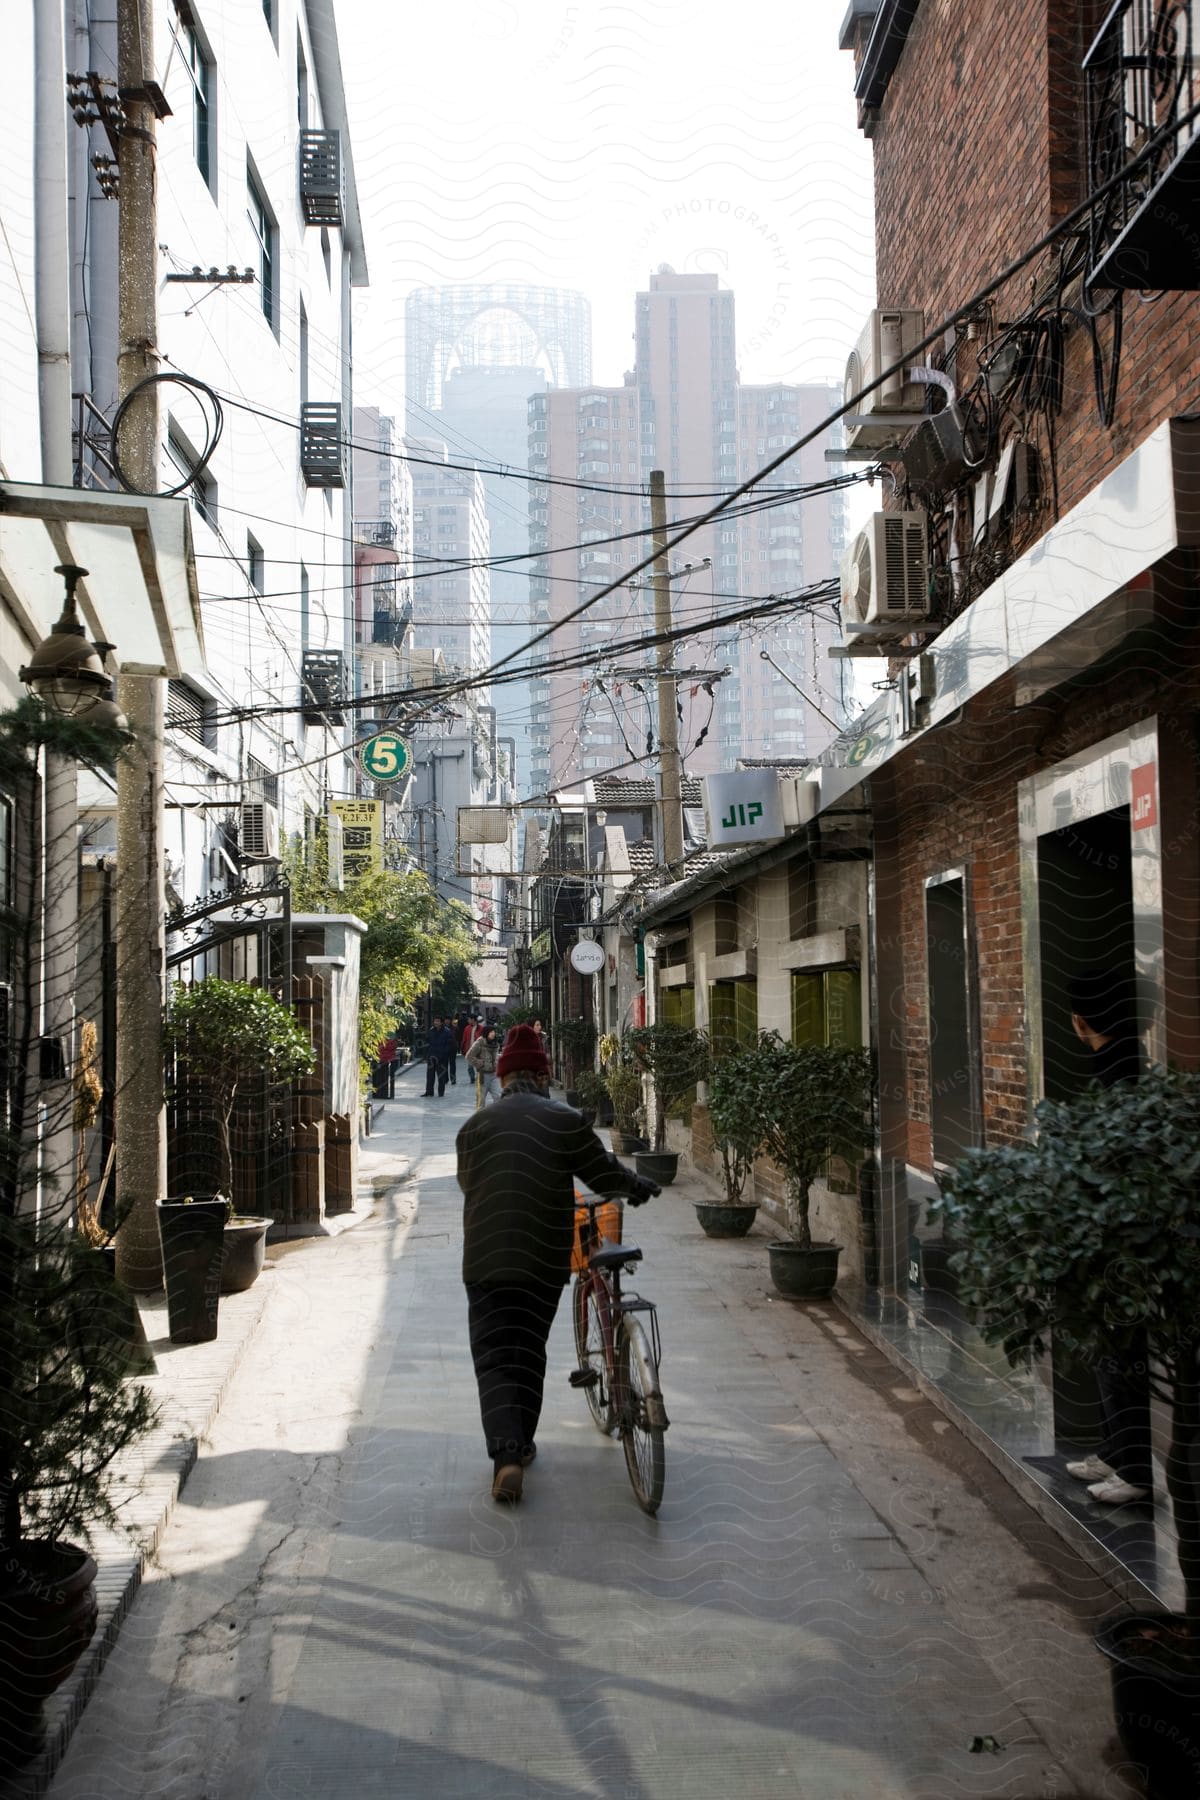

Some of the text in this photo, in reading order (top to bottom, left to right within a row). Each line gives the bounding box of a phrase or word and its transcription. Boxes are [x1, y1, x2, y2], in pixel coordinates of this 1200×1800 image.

[371, 741, 397, 773] 5
[339, 813, 375, 822] F.2F.3F
[721, 801, 764, 828] JIP
[1134, 793, 1151, 821] JIP
[343, 826, 372, 885] 画家
